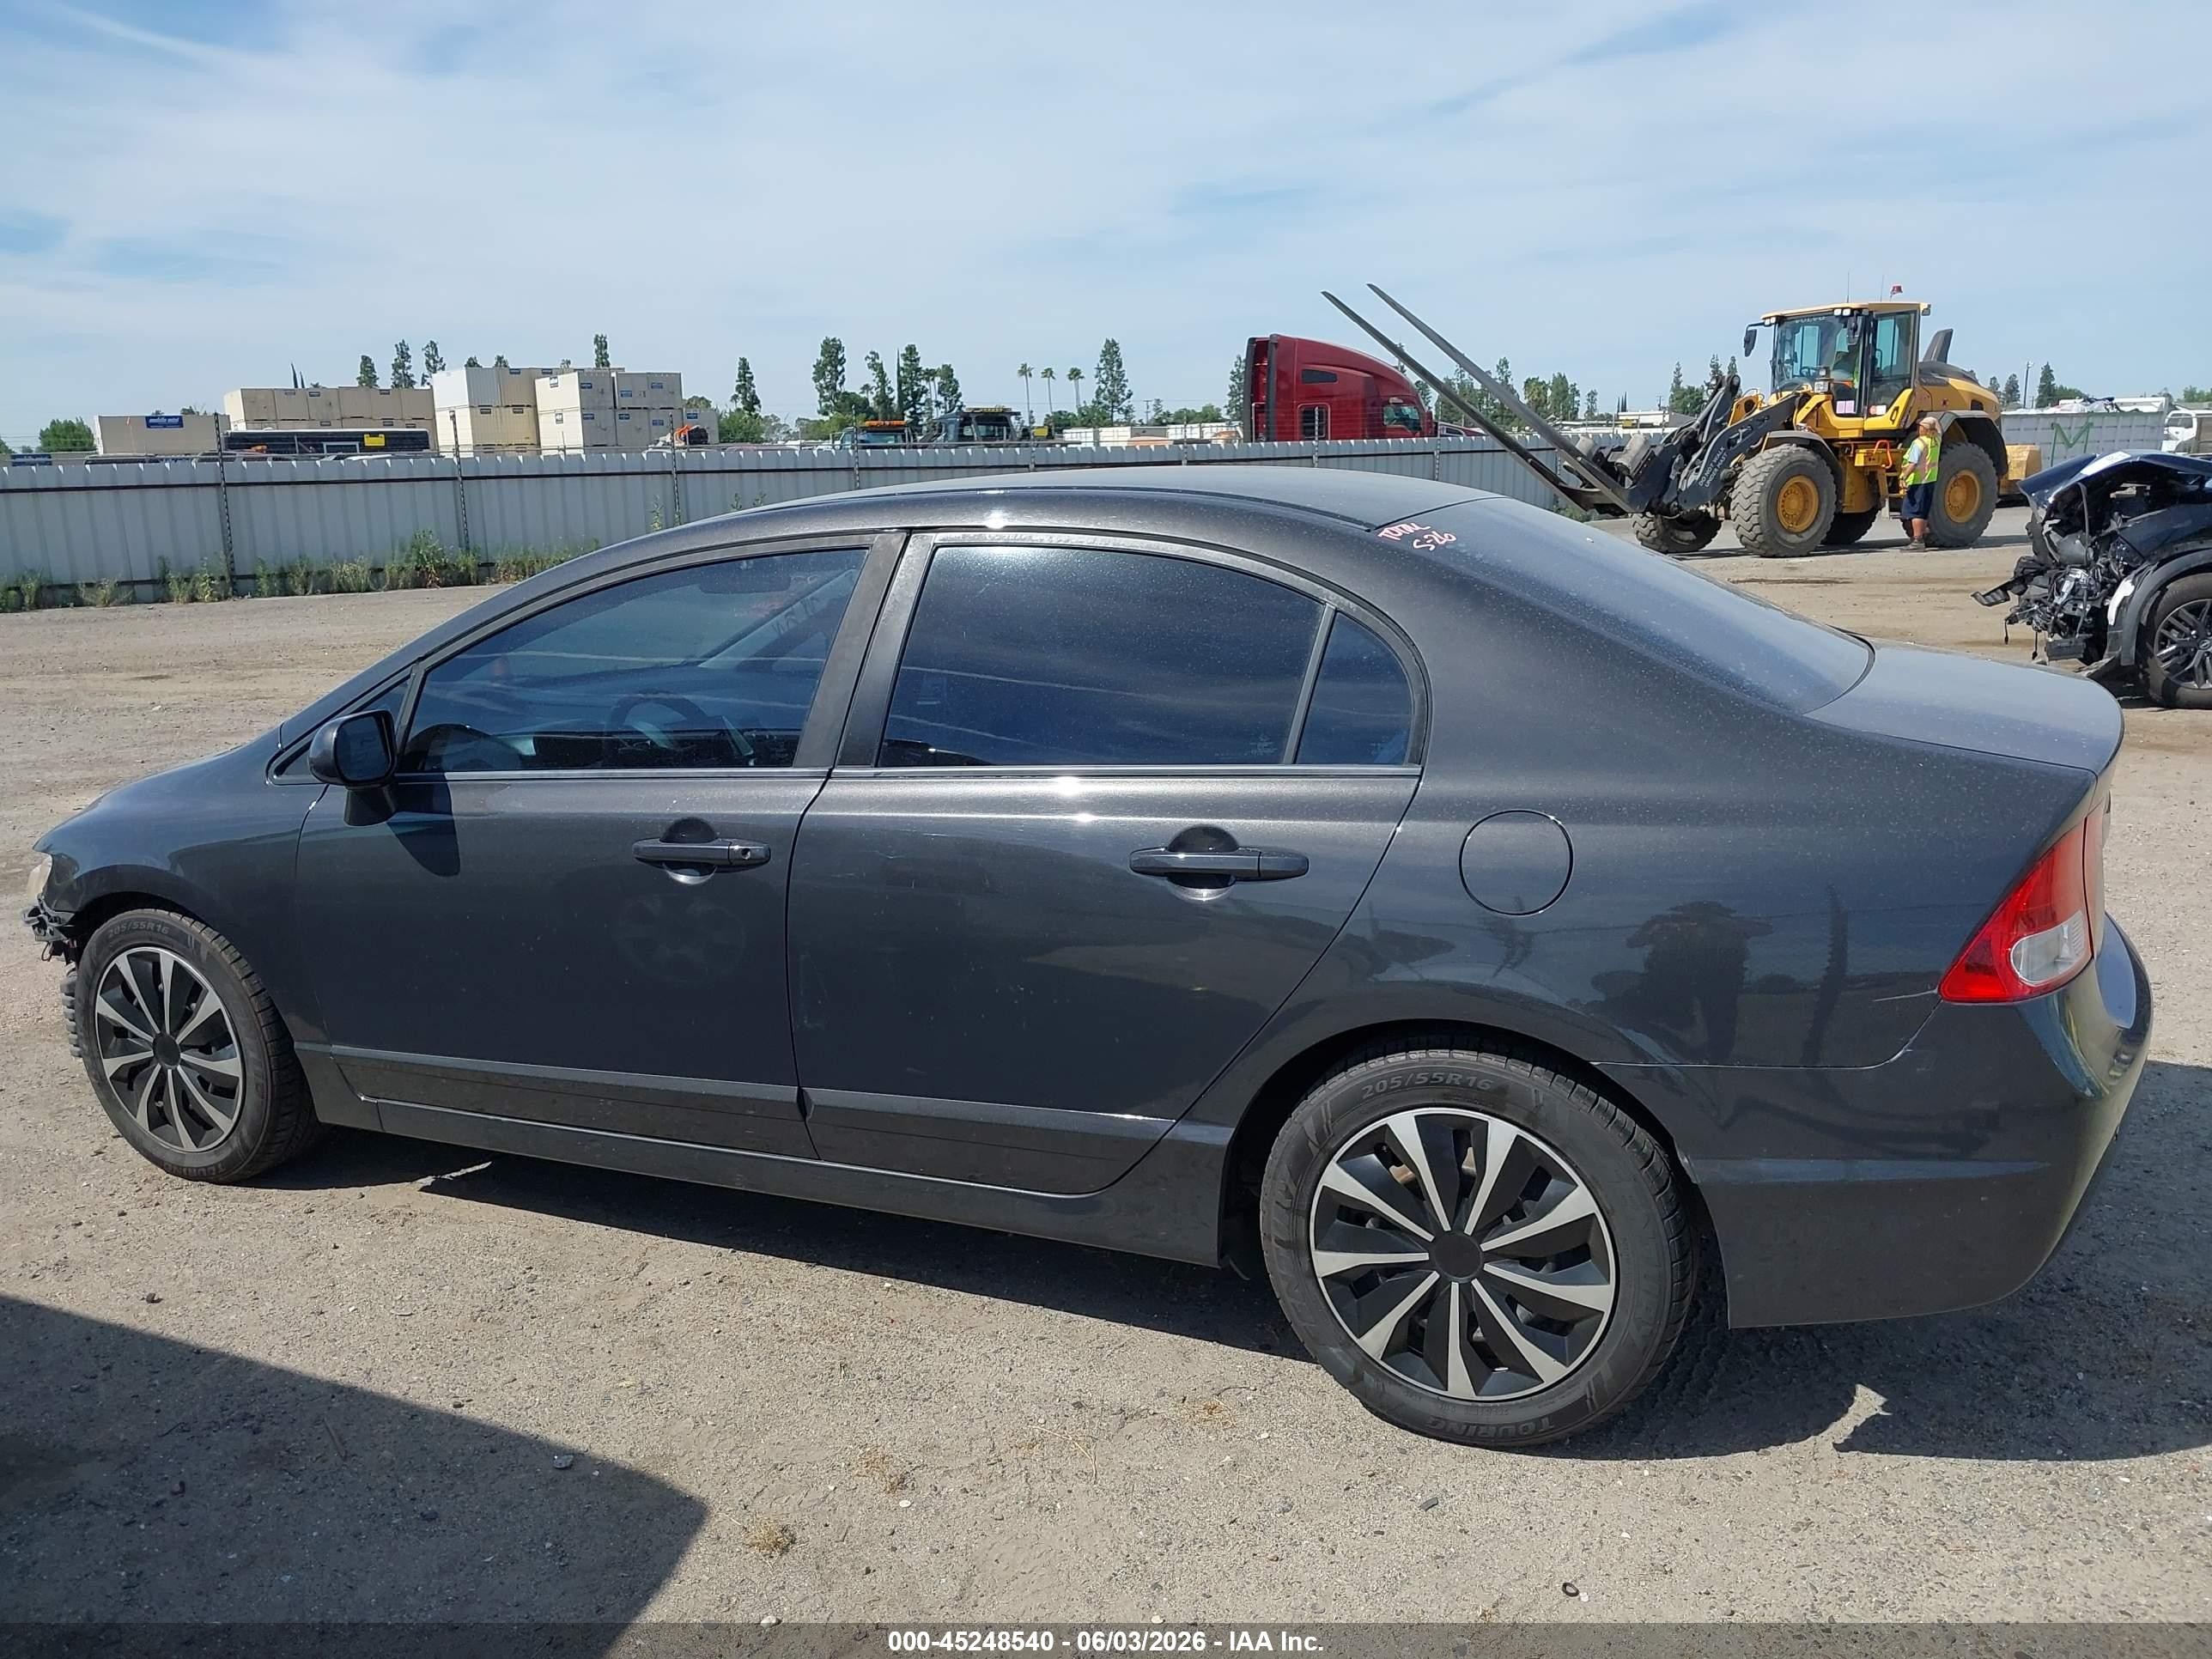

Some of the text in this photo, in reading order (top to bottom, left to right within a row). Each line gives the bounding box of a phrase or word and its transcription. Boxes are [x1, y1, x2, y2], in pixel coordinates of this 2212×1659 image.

[108, 920, 170, 939] 205/55R16
[1361, 1072, 1494, 1100] 205/55R16
[1425, 1415, 1556, 1439] TOURING
